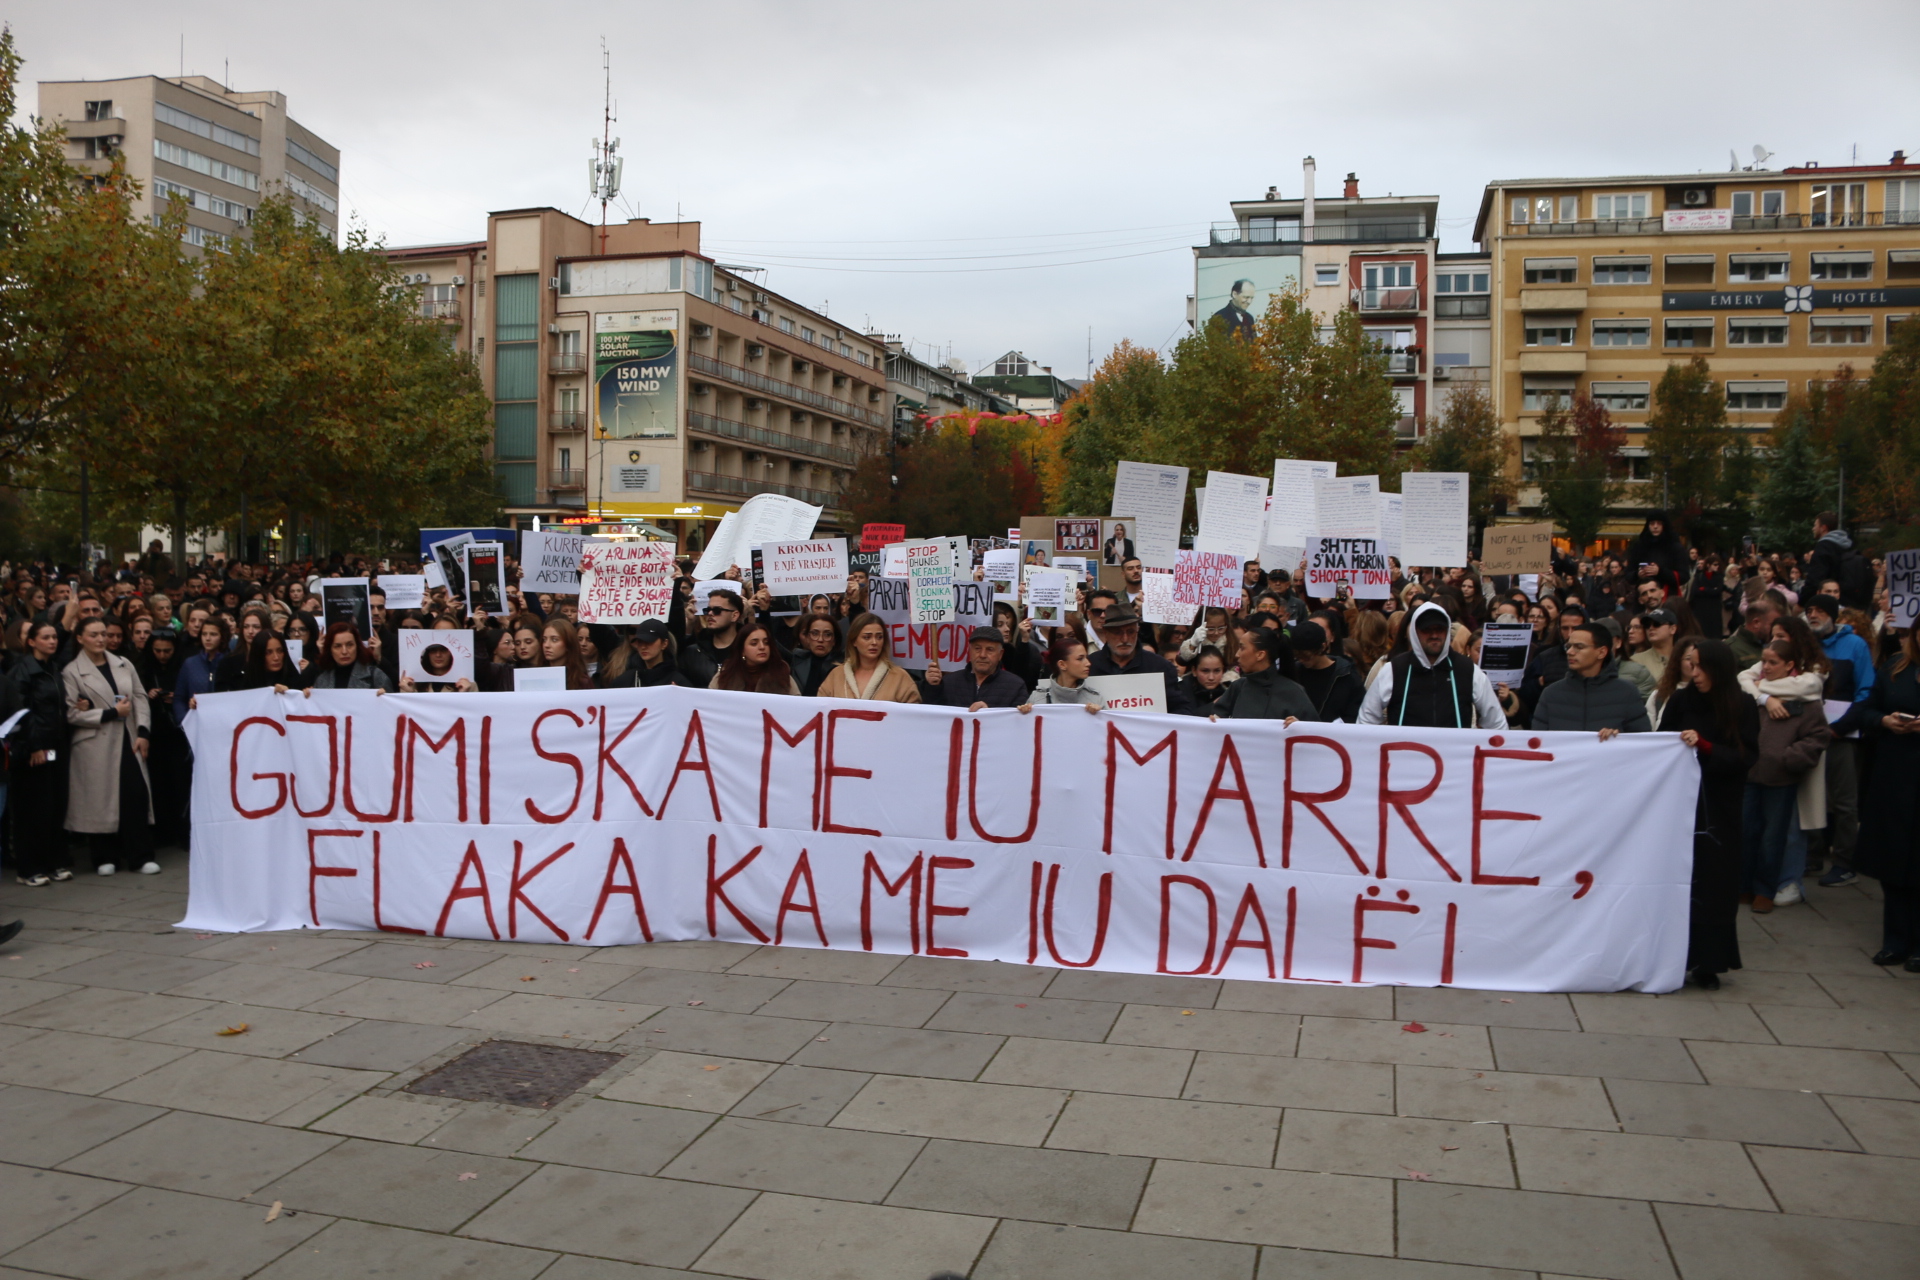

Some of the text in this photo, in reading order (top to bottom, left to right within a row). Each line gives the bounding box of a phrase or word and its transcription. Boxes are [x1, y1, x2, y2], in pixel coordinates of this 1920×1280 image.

[1710, 292, 1888, 306] EMERY HOTEL
[600, 336, 612, 344] 100
[600, 342, 628, 350] SOLAR
[600, 349, 639, 358] AUCTION
[617, 366, 671, 380] 150 MW
[618, 380, 660, 392] WIND
[1320, 538, 1376, 554] SHTETI
[1490, 534, 1550, 544] NOT ALL MEN
[605, 546, 652, 562] ARLINDA
[777, 542, 833, 555] KRONIKA
[908, 546, 938, 558] STOP
[541, 554, 576, 568] NUK KA
[774, 561, 780, 571] E
[781, 557, 796, 572] NJË
[798, 558, 836, 570] VRASJEJE
[910, 556, 940, 568] DHUNES
[1178, 550, 1238, 570] SA ARLINDA
[1313, 554, 1385, 570] S'NA MBRON
[1484, 560, 1544, 570] ALWAYS A MAN
[594, 562, 668, 576] NA FAL QË BOTA
[912, 566, 952, 577] NE FAMILJE
[1174, 564, 1224, 578] DUHET TE
[620, 576, 642, 588] ENDE
[645, 575, 666, 588] NUK
[785, 574, 838, 582] PARALAJMËRUAR
[1174, 574, 1235, 588] HUMBASIM QE
[1362, 570, 1392, 585] TONA
[588, 588, 621, 602] ËSHTË
[626, 588, 632, 601] E
[920, 587, 952, 598] DONIKA
[1174, 582, 1194, 594] JETA
[1209, 586, 1222, 596] NJE
[598, 600, 668, 617] PËR GRATË
[1218, 596, 1242, 610] VLEJE
[918, 610, 946, 622] STOP
[406, 632, 422, 650] AM
[444, 633, 472, 658] NEXT?
[1106, 694, 1154, 709] vrasin
[229, 713, 492, 825] GJUMI
[524, 705, 722, 825] S'KA
[758, 708, 888, 837] ME
[944, 714, 1043, 845] IU
[307, 827, 655, 943] FLAKA
[705, 833, 830, 947] KA
[859, 850, 975, 958] ME
[1026, 860, 1113, 969] IU
